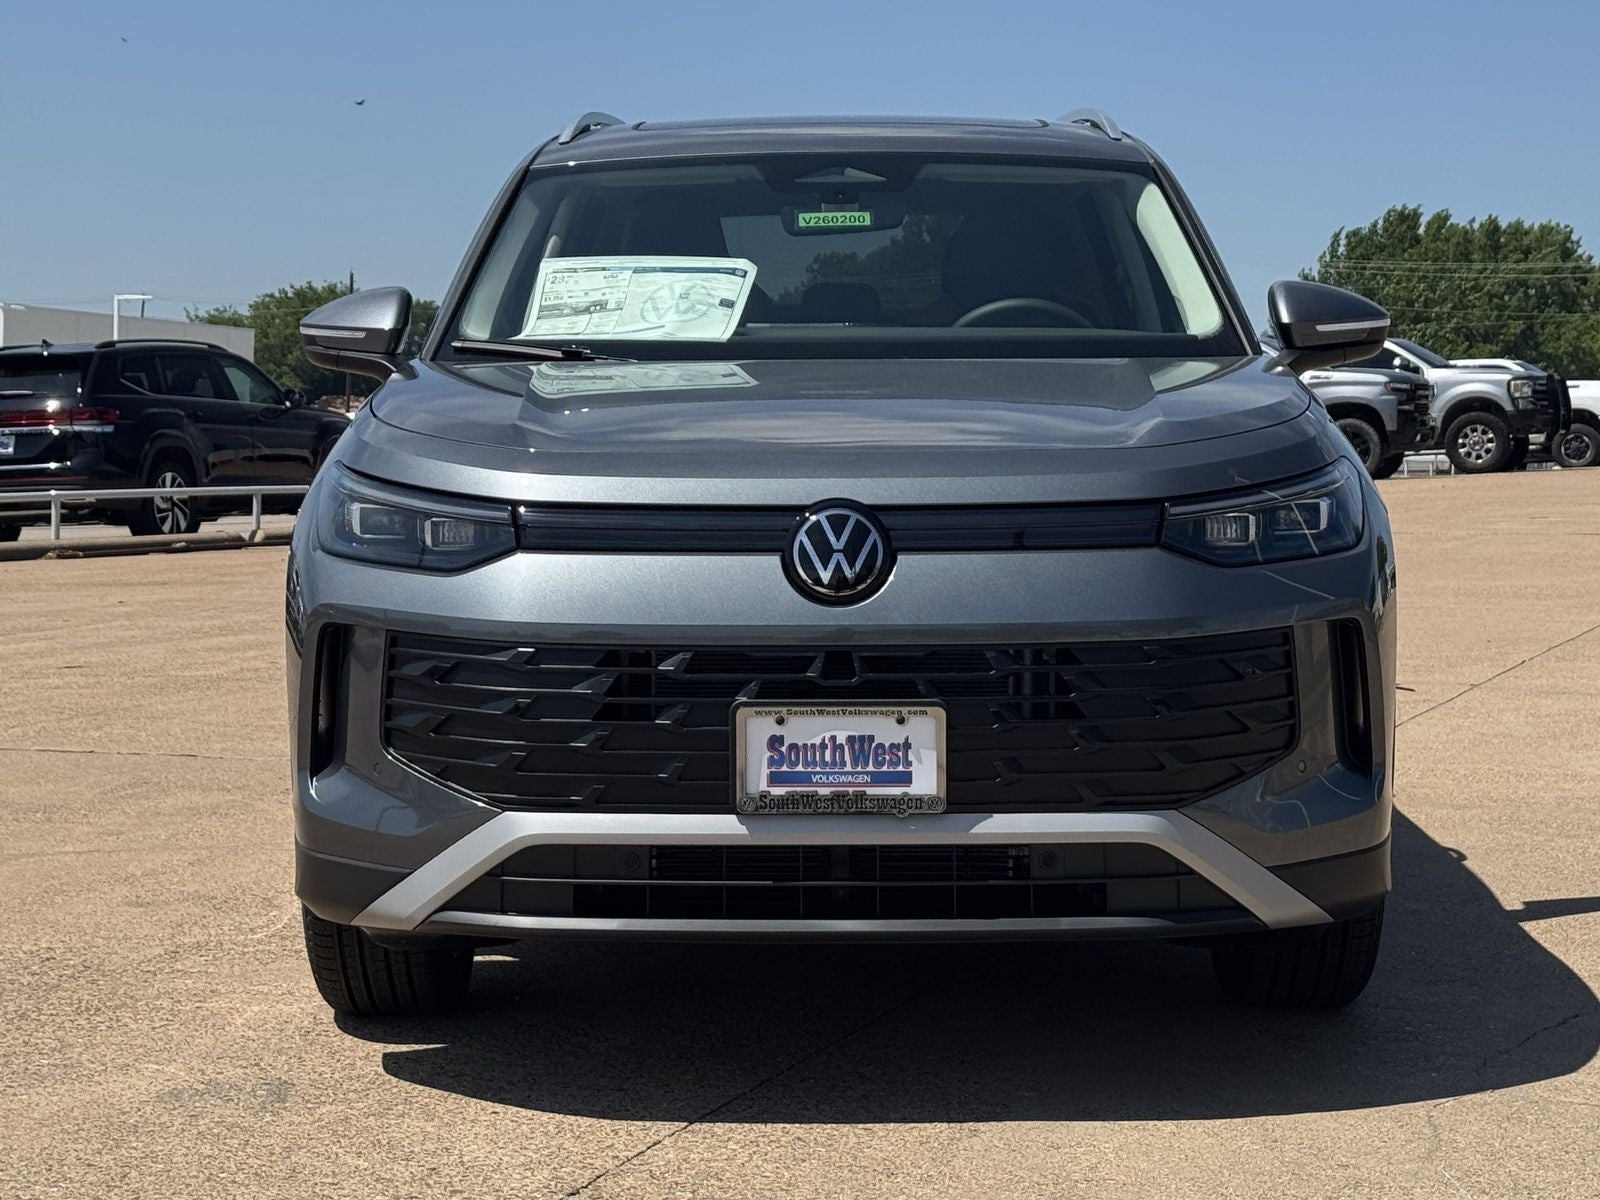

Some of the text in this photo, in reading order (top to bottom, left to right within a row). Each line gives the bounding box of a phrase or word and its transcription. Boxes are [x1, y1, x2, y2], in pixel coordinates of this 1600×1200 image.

[802, 214, 867, 225] V260200
[753, 708, 929, 717] www.SouthWestVolkswagen.com
[811, 773, 871, 784] VOLKSWAGEN
